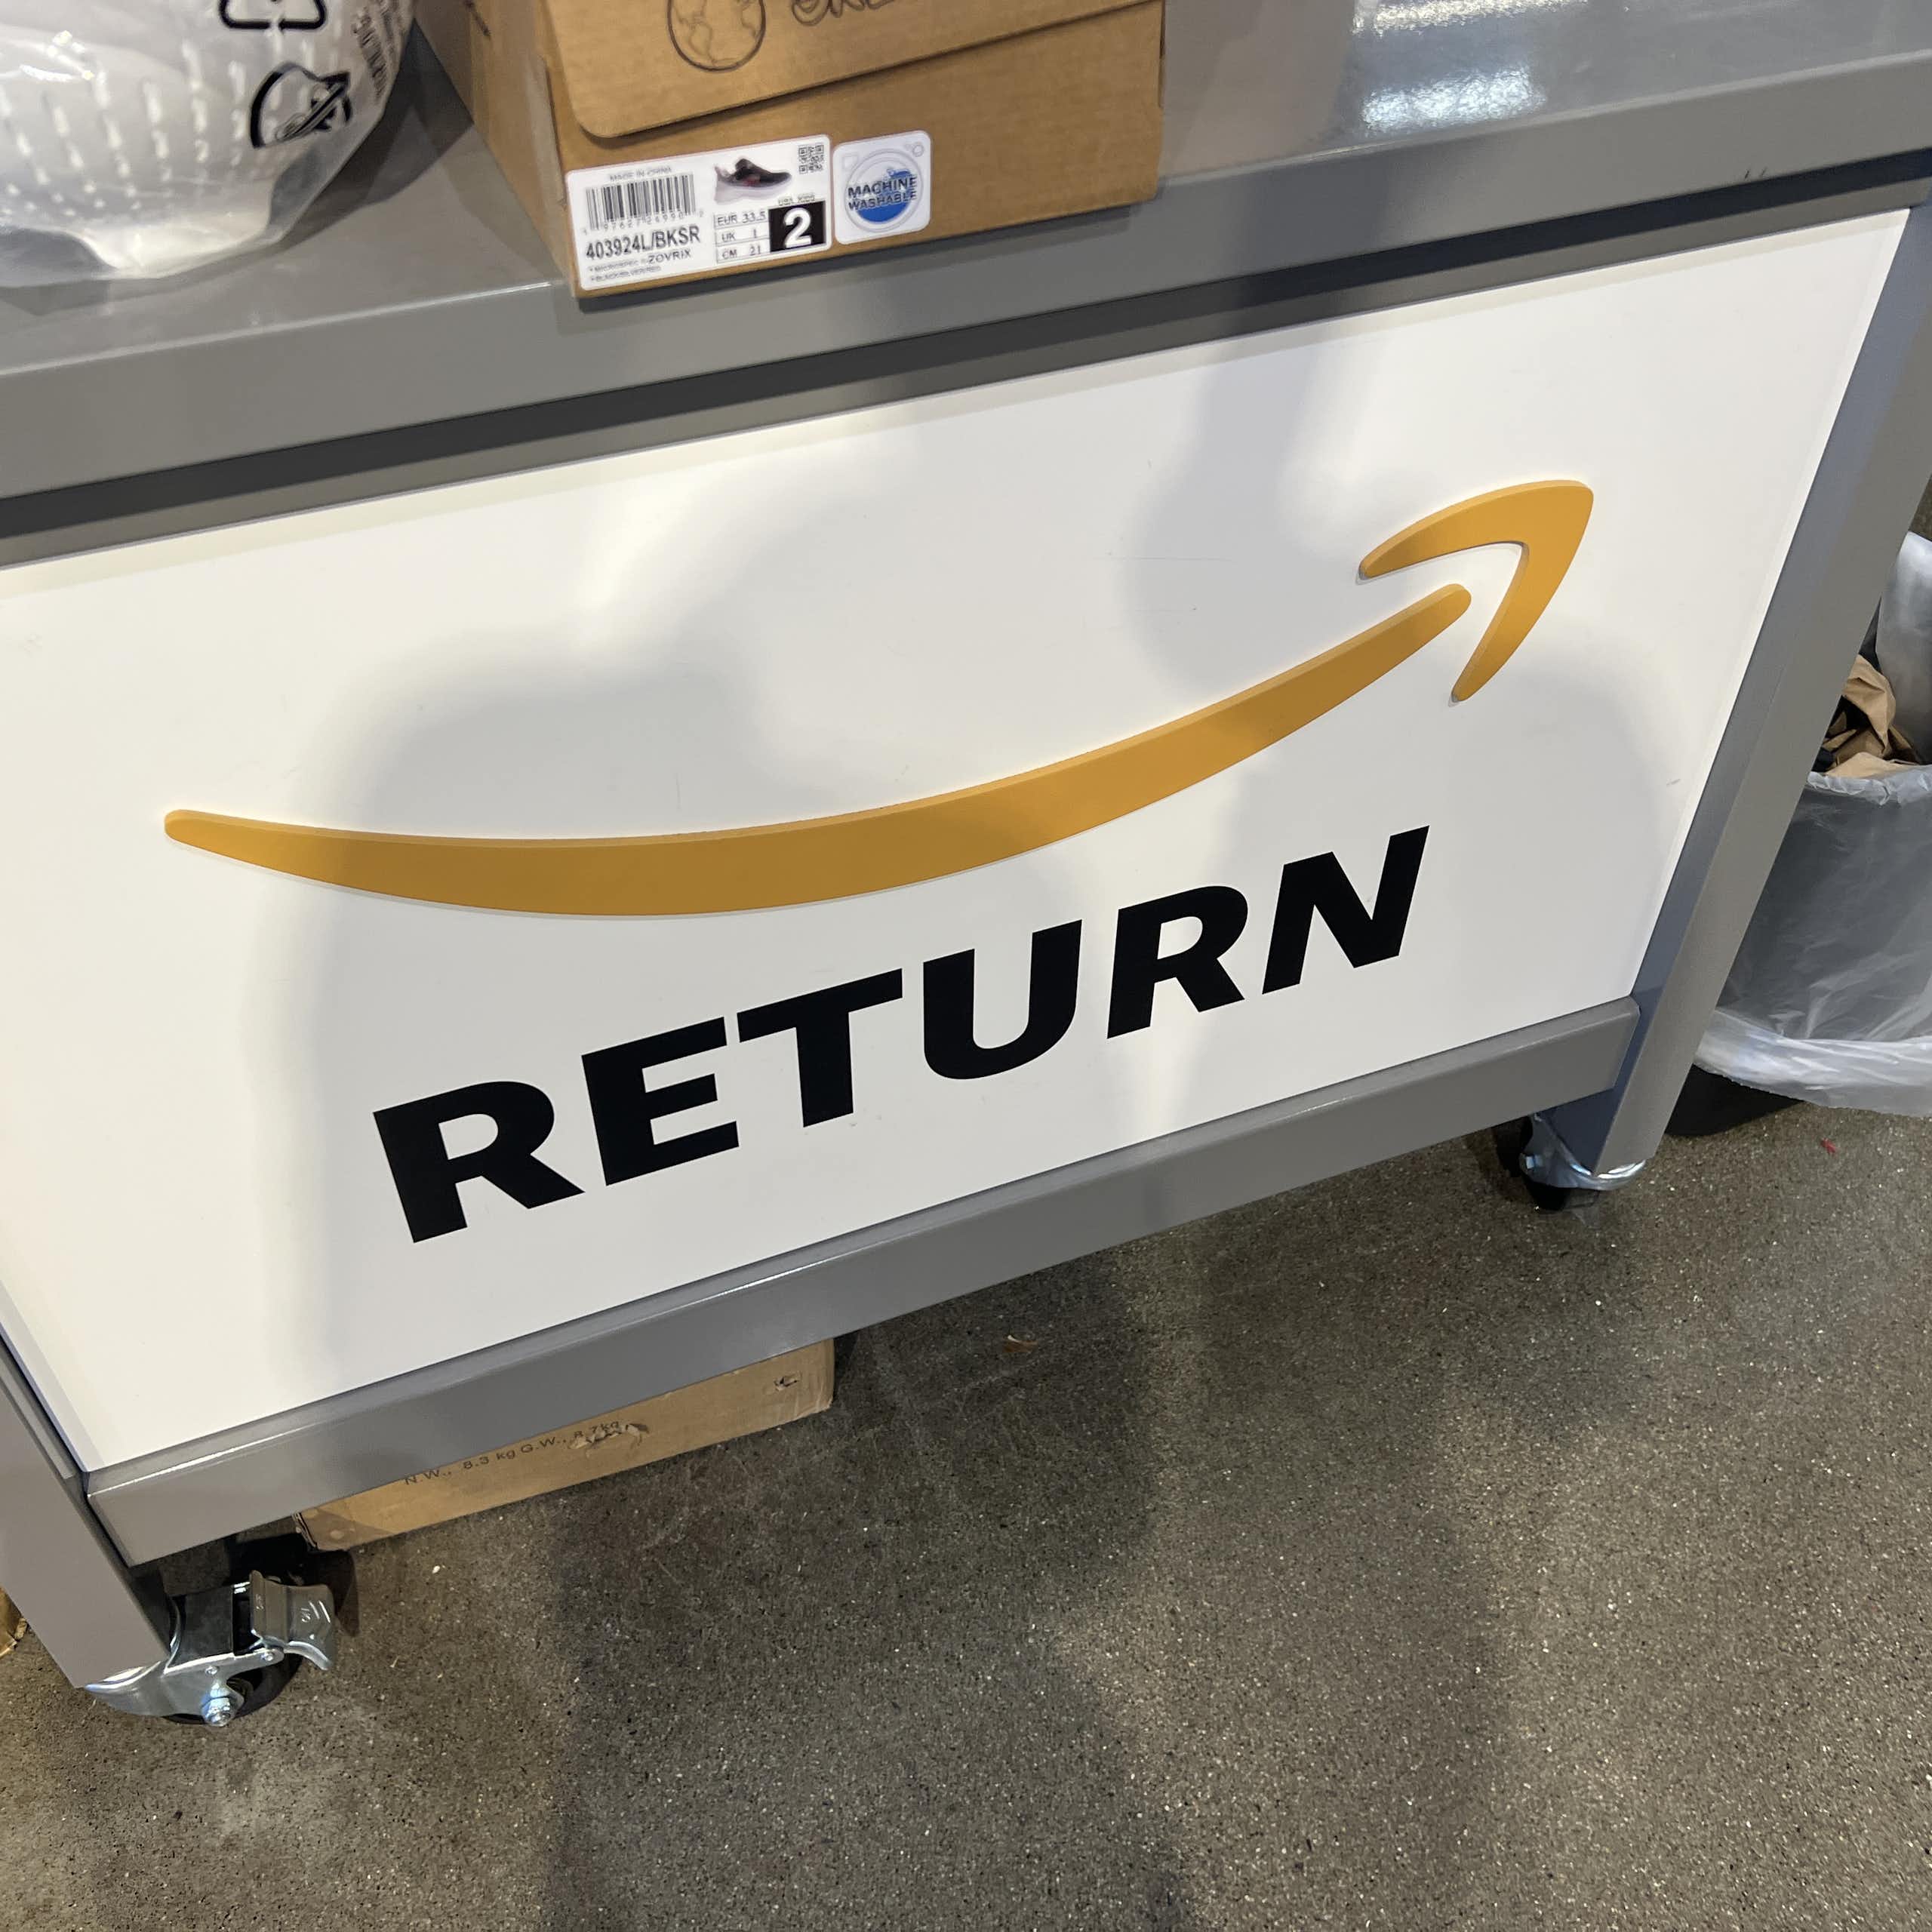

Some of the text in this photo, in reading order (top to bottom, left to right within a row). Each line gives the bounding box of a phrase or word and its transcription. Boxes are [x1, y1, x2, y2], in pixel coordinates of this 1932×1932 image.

[848, 174, 918, 198] MACHINE
[848, 188, 918, 211] WASHABLE
[717, 211, 767, 226] EUR 33.5
[783, 208, 813, 248] 2
[586, 223, 701, 260] 403924L/BKSR
[721, 232, 737, 243] UK
[722, 245, 761, 260] CM 21
[374, 826, 1429, 1242] RETURN
[463, 1456, 490, 1470] 8.3
[496, 1450, 515, 1460] kg
